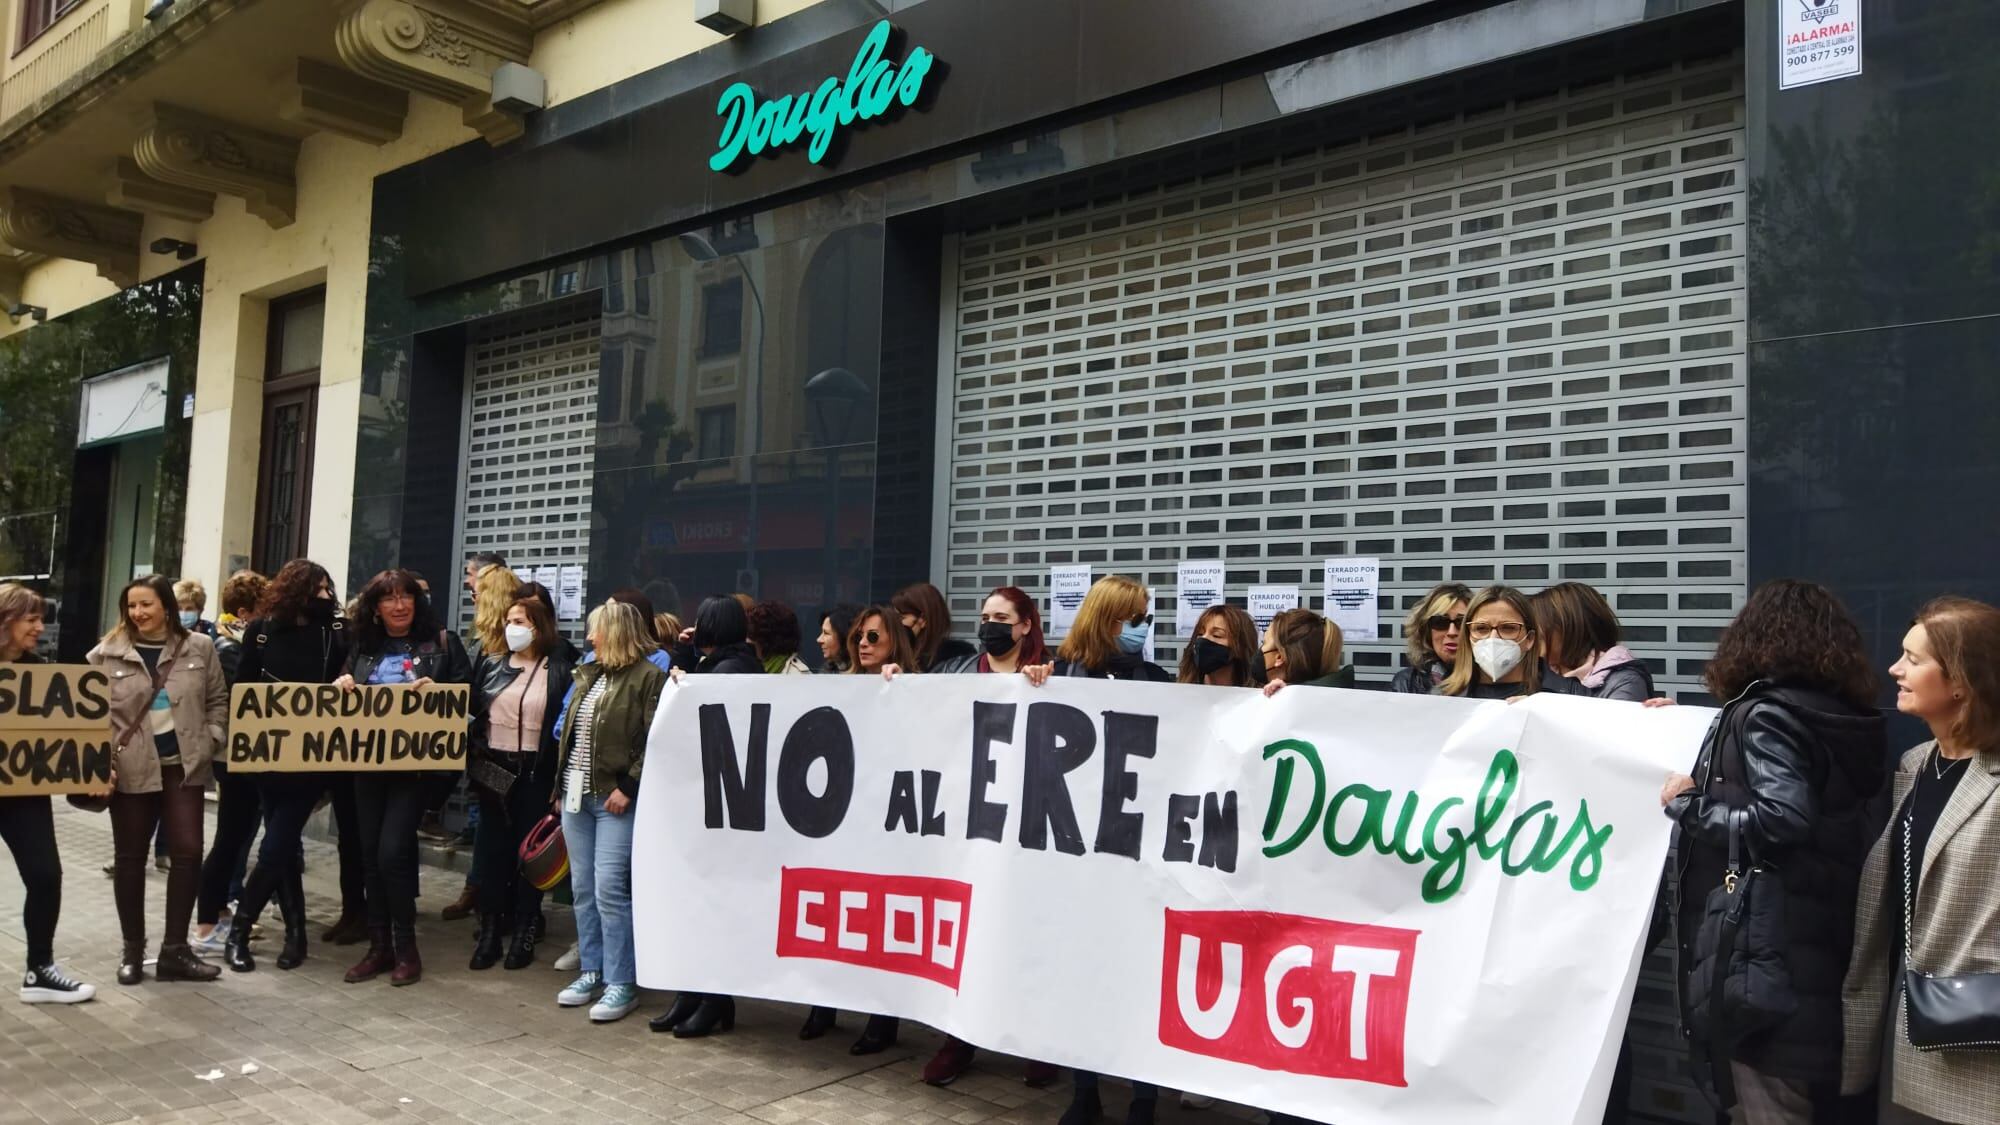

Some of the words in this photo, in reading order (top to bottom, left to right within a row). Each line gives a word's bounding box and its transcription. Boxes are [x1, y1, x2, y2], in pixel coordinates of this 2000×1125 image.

[1787, 21, 1854, 45] ¡ALARMA!
[1787, 55, 1807, 67] 900
[1810, 50, 1830, 63] 877
[1833, 44, 1854, 58] 599
[709, 20, 933, 171] Douglas
[1180, 568, 1207, 576] CERRADO
[1337, 576, 1365, 584] HUELGA
[236, 685, 394, 719] AKORDIO
[401, 689, 467, 719] DUIN
[231, 729, 291, 762] BAT
[302, 727, 386, 764] NAHI
[390, 729, 467, 761] DUGU
[698, 702, 855, 838] NO
[885, 769, 946, 837] AL
[966, 701, 1160, 861] ERE
[1164, 790, 1238, 874] EN
[1261, 738, 1613, 904] Douglas
[795, 889, 963, 970] CCOO
[1176, 933, 1401, 1062] UGT
